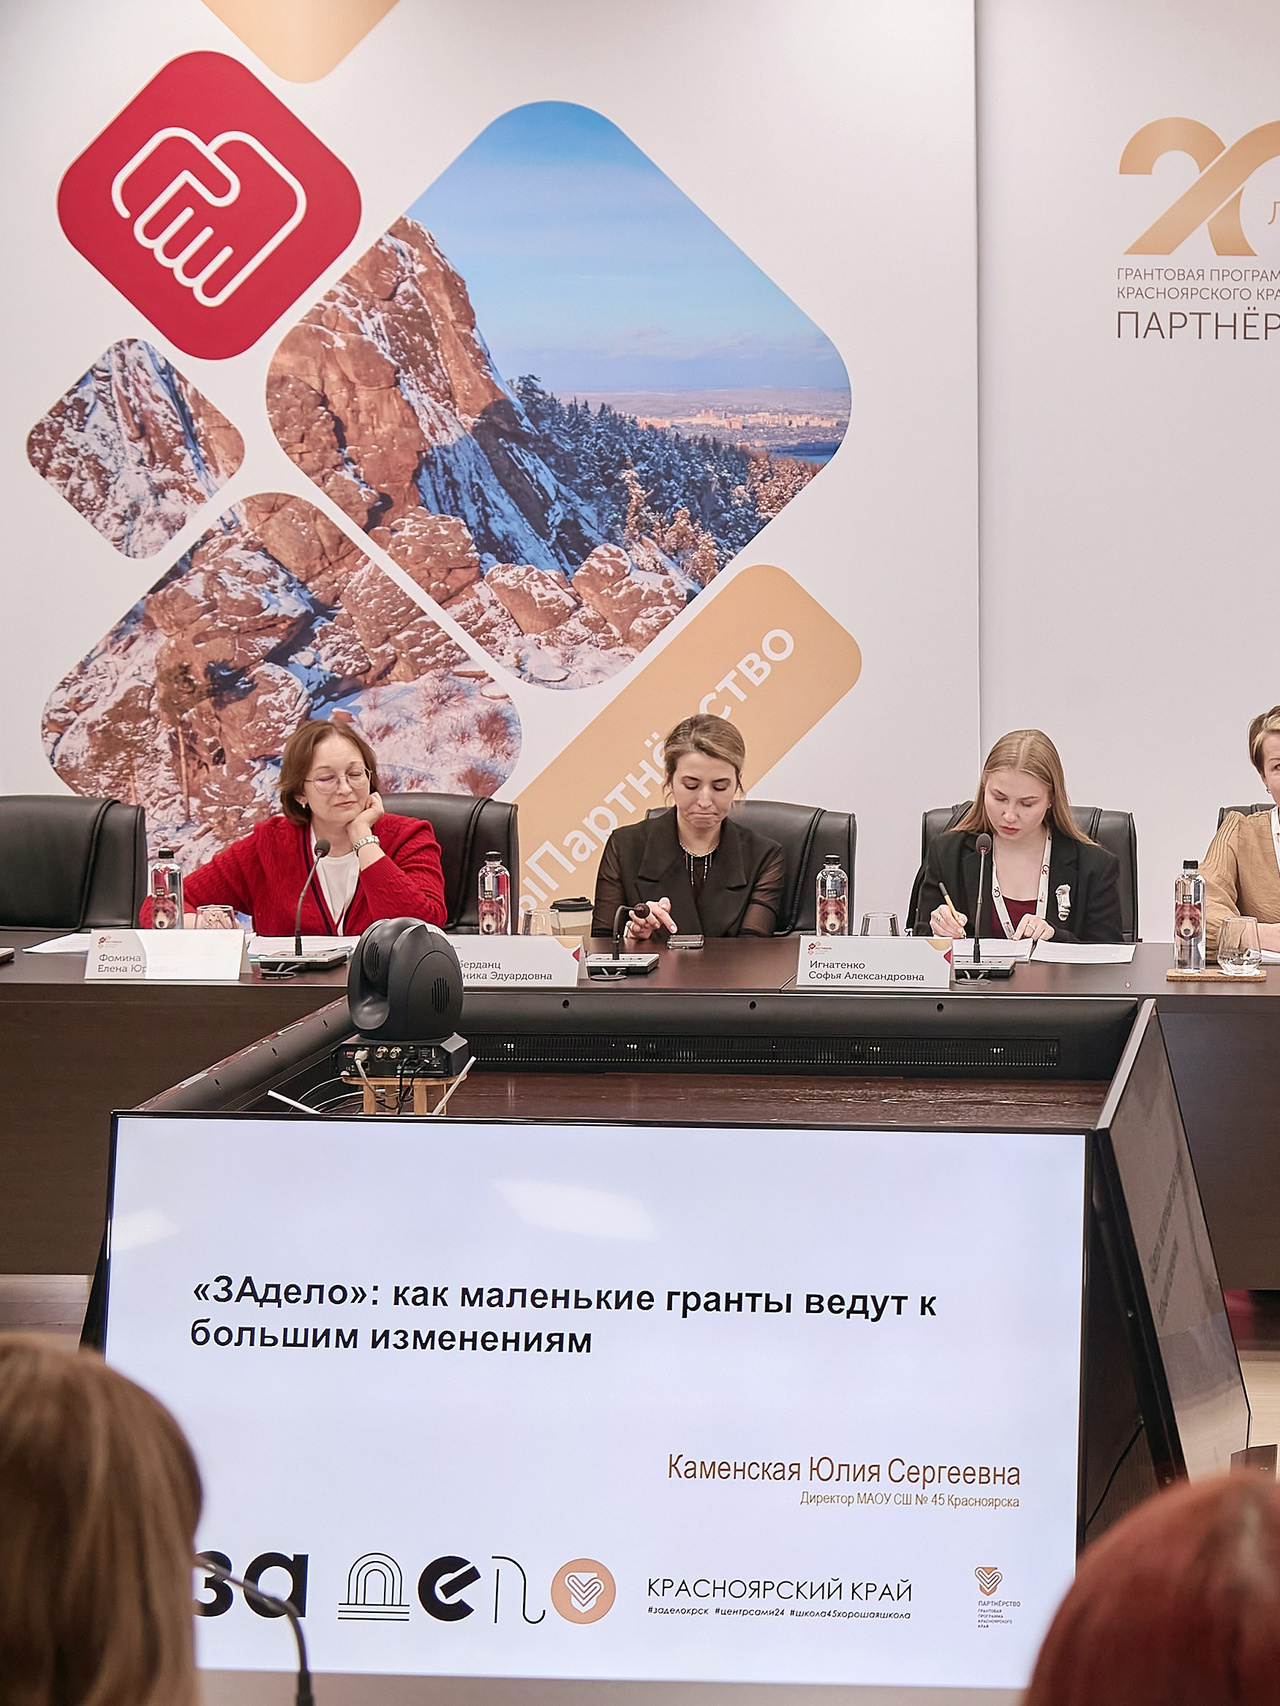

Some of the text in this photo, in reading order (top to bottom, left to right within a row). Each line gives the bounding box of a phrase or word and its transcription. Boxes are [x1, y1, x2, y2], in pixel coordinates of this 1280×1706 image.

[1118, 268, 1204, 281] ГРАНТОВАЯ
[1118, 287, 1251, 300] КРАСНОЯРСКОГО
[99, 954, 141, 962] Фомина
[810, 961, 865, 969] Игнатенко
[491, 972, 552, 981] Эдуардовна
[809, 971, 924, 982] Софья Александровна
[194, 1276, 936, 1322] «ЗАдело»: как маленькие гранты ведут к
[191, 1318, 591, 1353] большим изменениям
[669, 1454, 1020, 1490] Каменская Юлия Сергеевна
[800, 1491, 1019, 1509] Директор МАОУ СШ № 45 Красноярска
[648, 1578, 911, 1601] КРАСНОЯРСКИЙ КРАЙ
[648, 1607, 910, 1619] #заделокрск #центрсами24 #школа45хорошаяшкола
